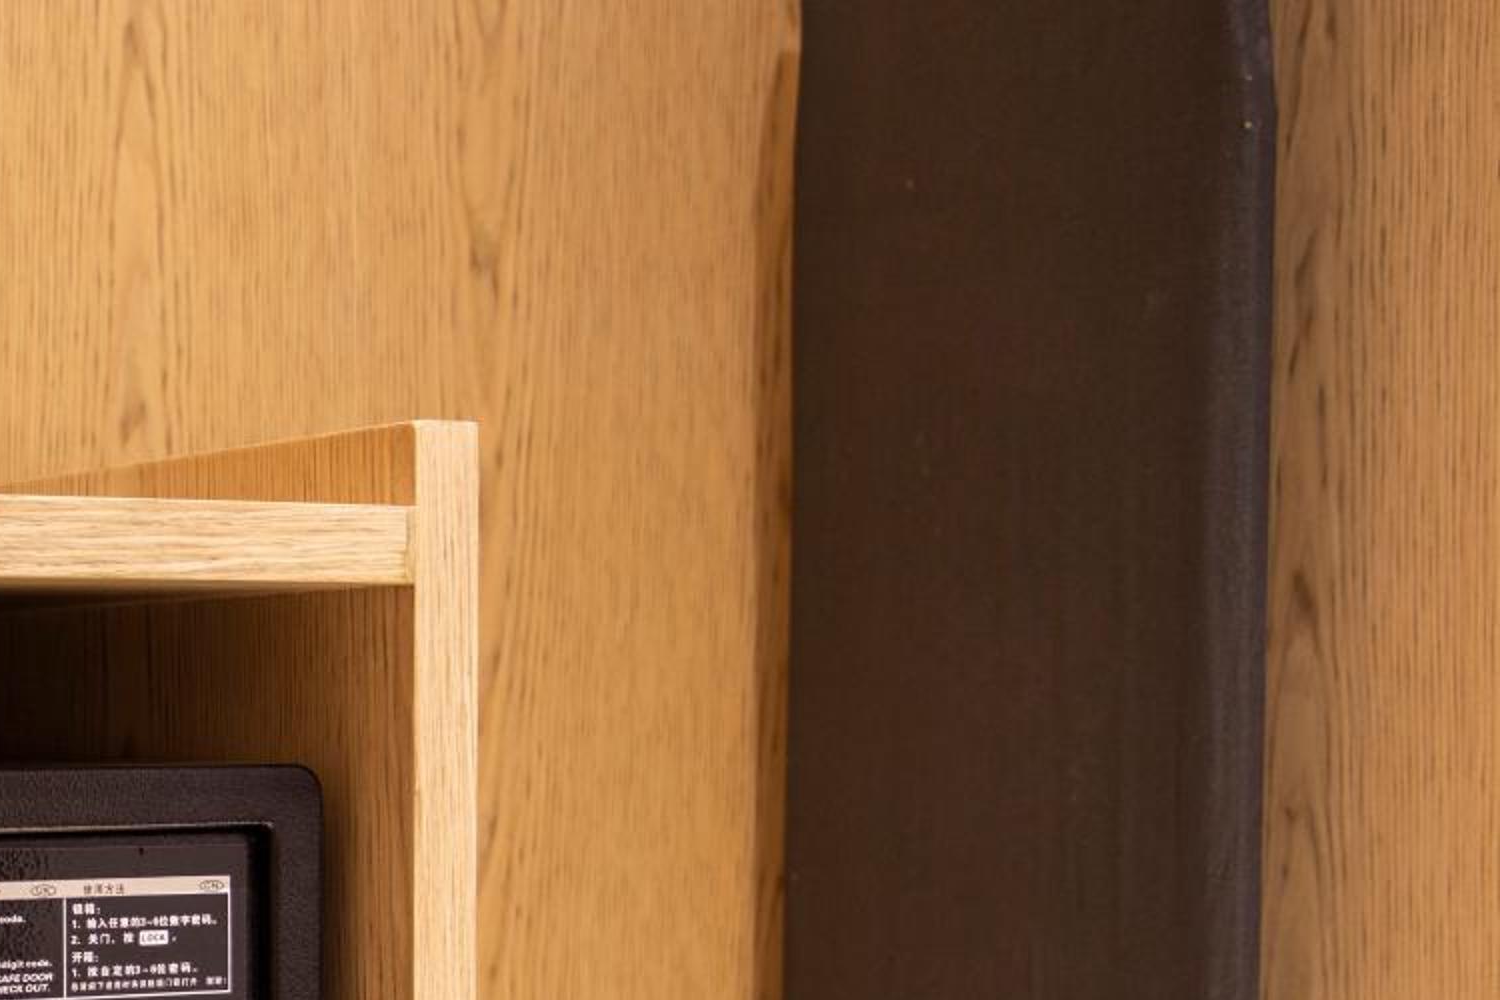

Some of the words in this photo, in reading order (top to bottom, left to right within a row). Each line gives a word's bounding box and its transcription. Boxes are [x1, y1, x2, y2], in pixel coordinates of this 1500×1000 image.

[71, 918, 81, 929] 1.
[70, 935, 81, 946] 2.
[141, 932, 165, 942] LOCK
[22, 973, 53, 983] DOOR
[71, 967, 81, 978] 1.
[25, 984, 51, 993] OUT.
